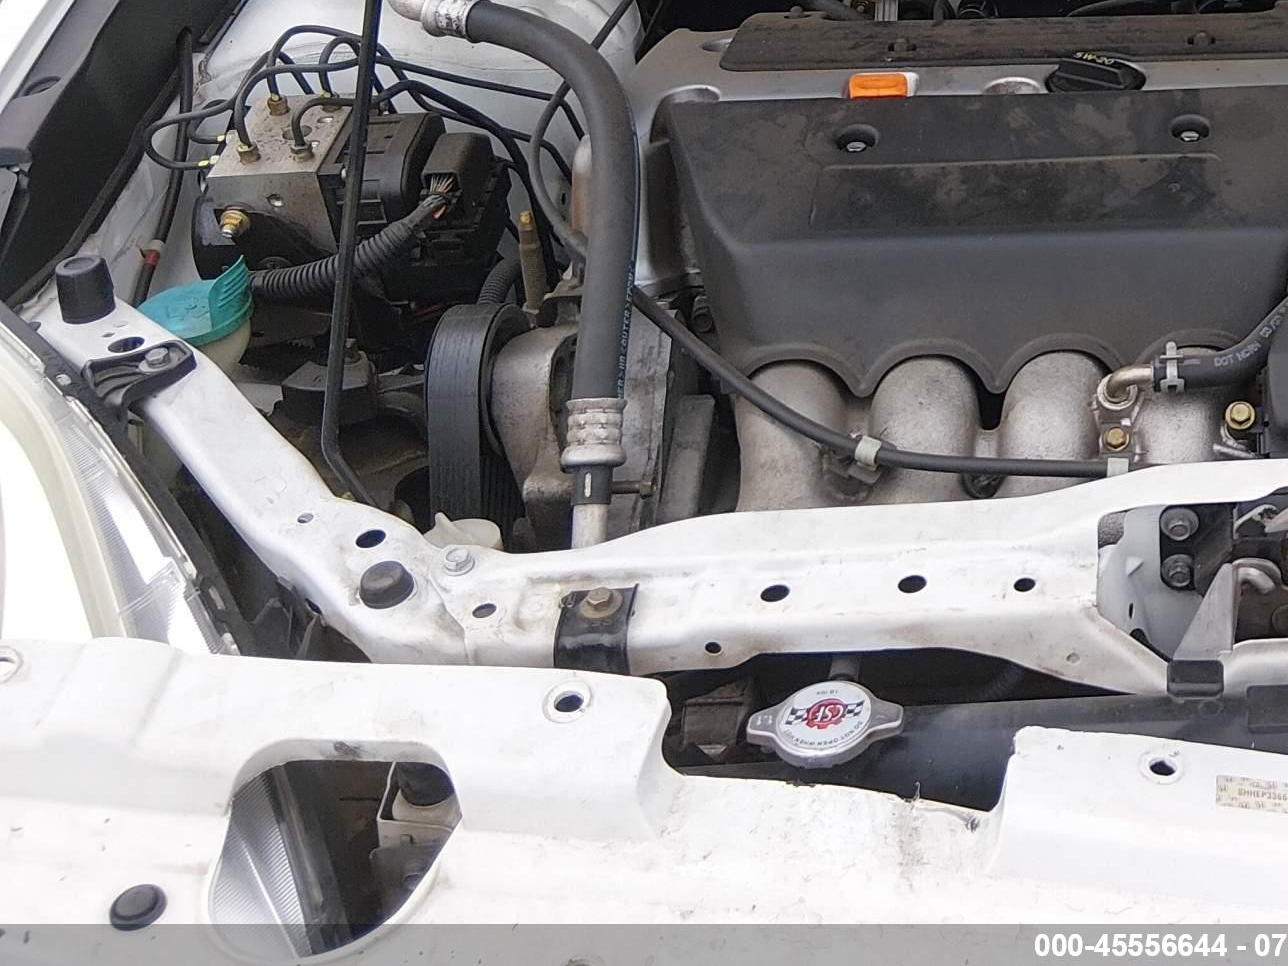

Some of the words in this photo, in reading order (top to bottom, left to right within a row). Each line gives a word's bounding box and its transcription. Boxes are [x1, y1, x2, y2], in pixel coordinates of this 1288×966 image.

[1073, 50, 1115, 65] 5W-20
[816, 704, 844, 722] CSF
[816, 737, 839, 747] OPEN
